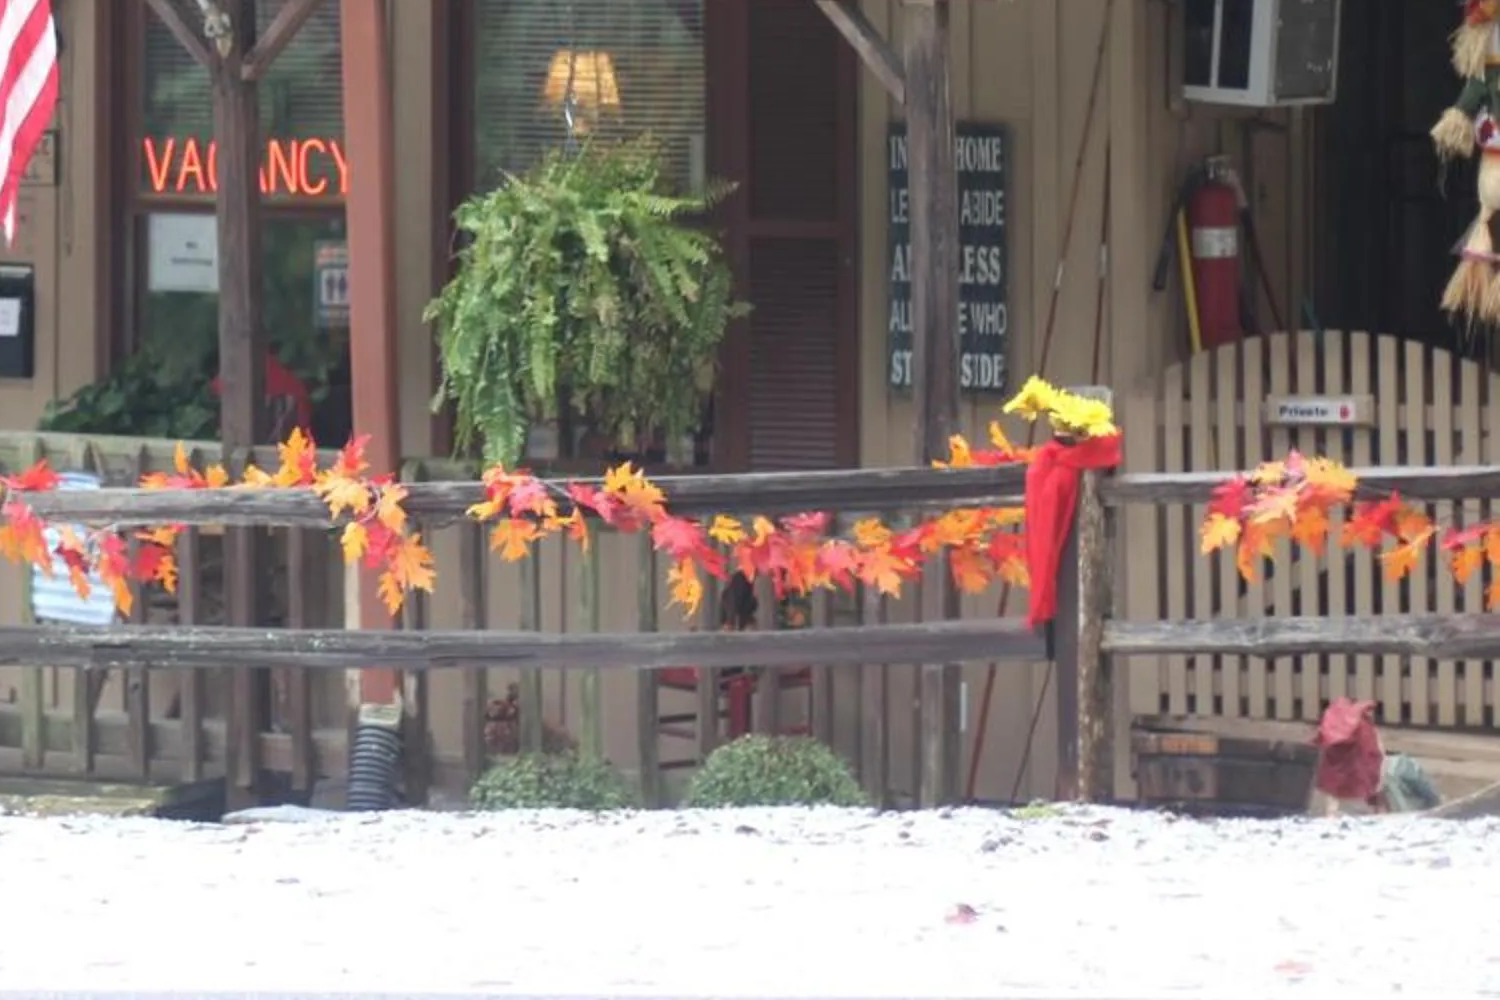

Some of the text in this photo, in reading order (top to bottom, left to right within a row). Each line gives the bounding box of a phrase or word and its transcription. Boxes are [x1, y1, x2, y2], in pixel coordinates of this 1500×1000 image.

[143, 136, 349, 196] VANCY
[955, 136, 1002, 172] HOME
[890, 187, 1005, 226] LE ABIDE
[959, 245, 1001, 284] ESS
[970, 302, 1007, 335] WHO
[891, 350, 1004, 388] ST SIDE
